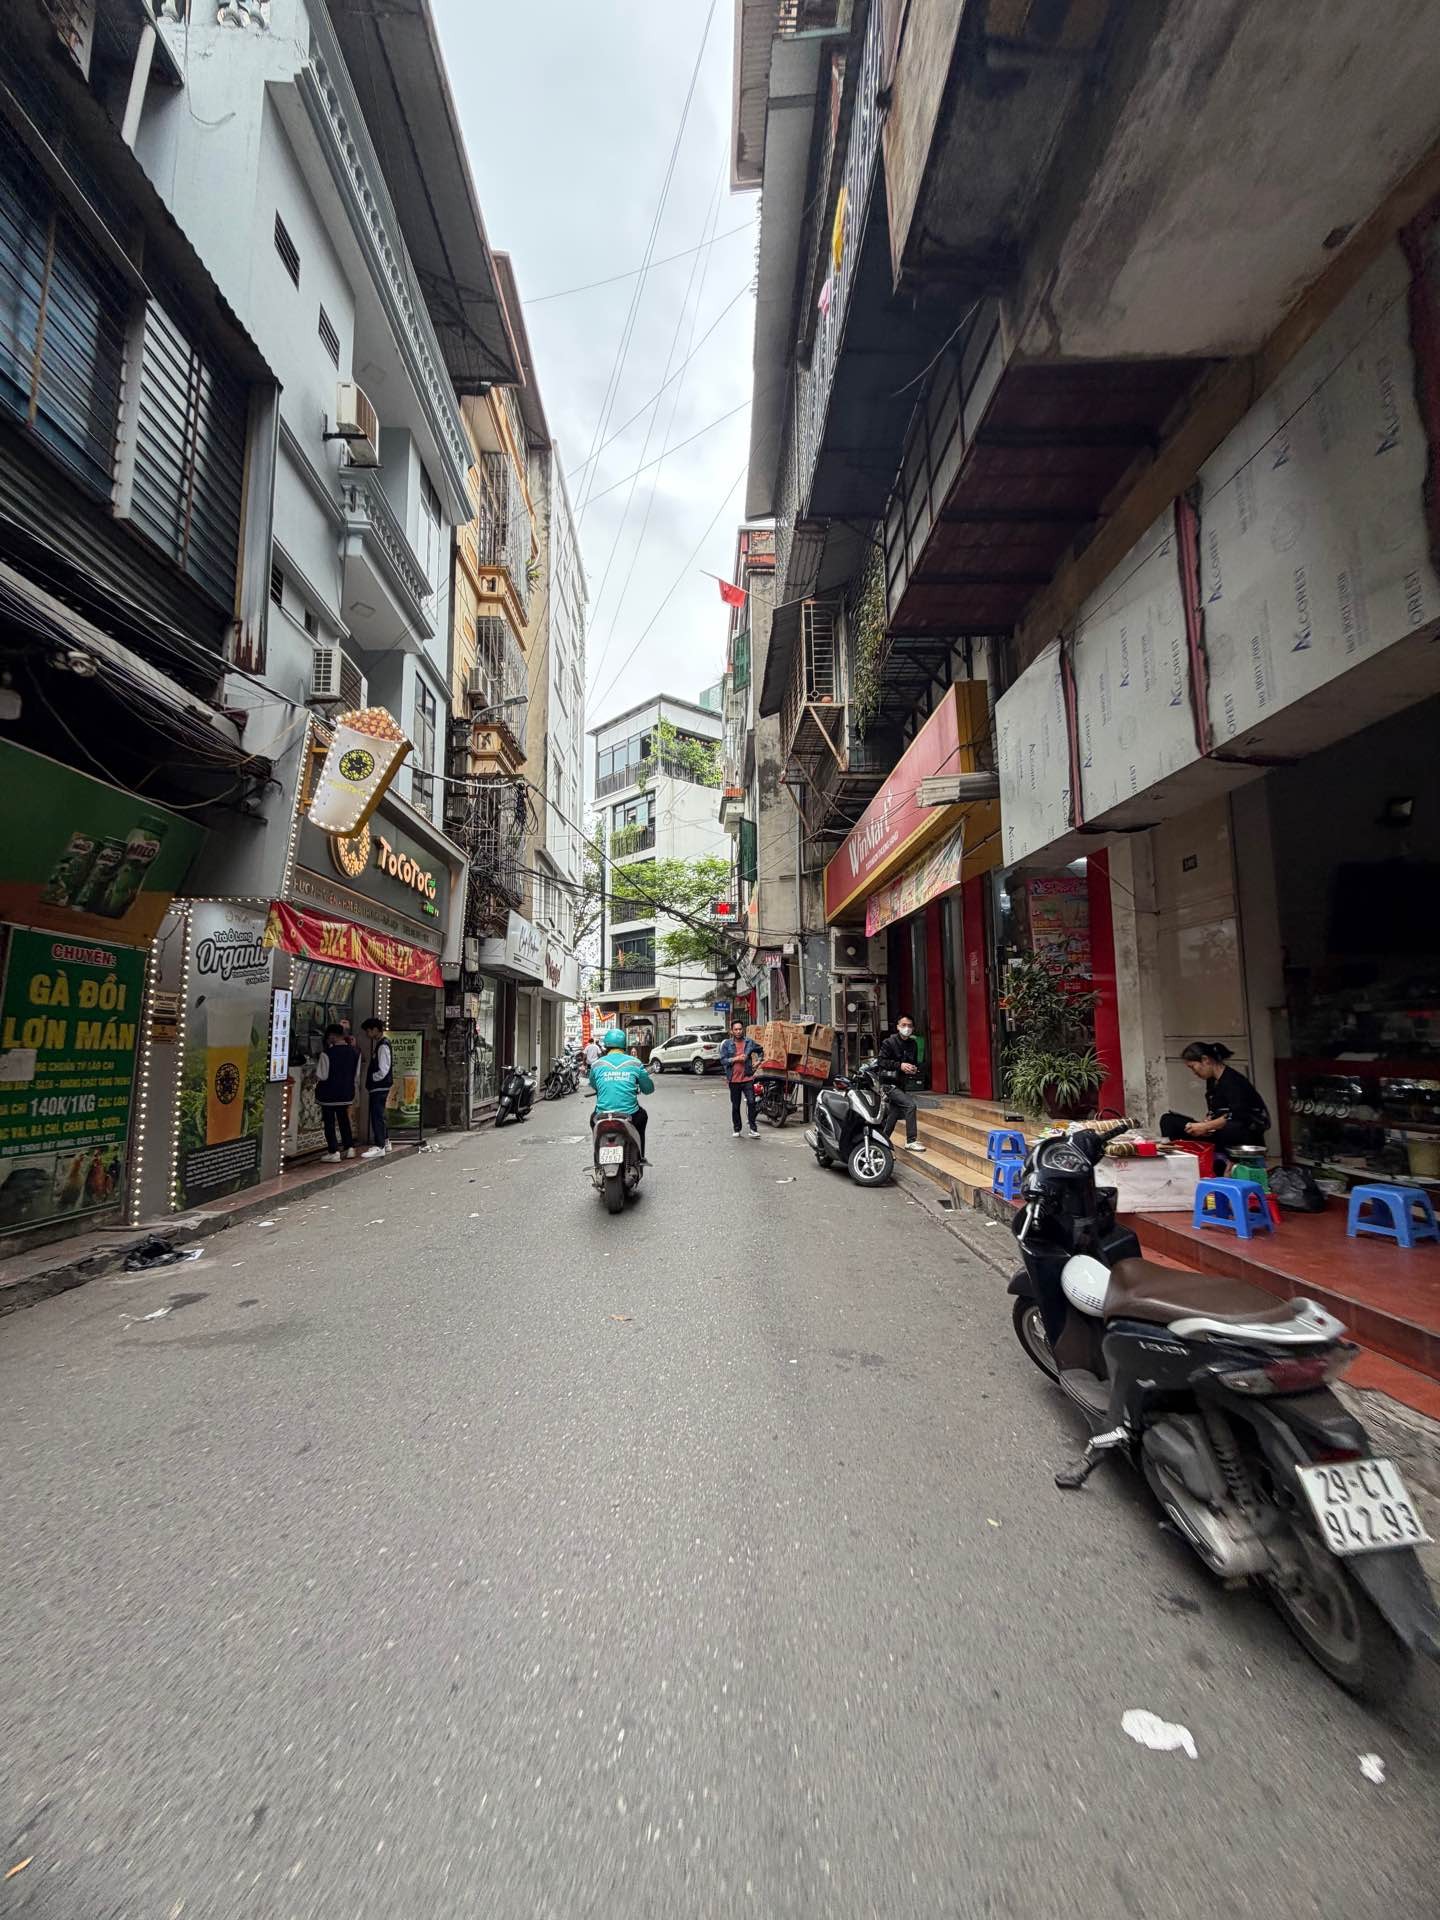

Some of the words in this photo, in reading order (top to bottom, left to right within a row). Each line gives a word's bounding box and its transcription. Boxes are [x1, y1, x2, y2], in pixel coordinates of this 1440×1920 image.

[29, 969, 70, 1007] GÀ
[75, 1016, 136, 1050] MÁN
[31, 1094, 96, 1117] 140K/1KG
[1314, 1461, 1394, 1504] 29-C1
[1325, 1502, 1420, 1546] 942.93
